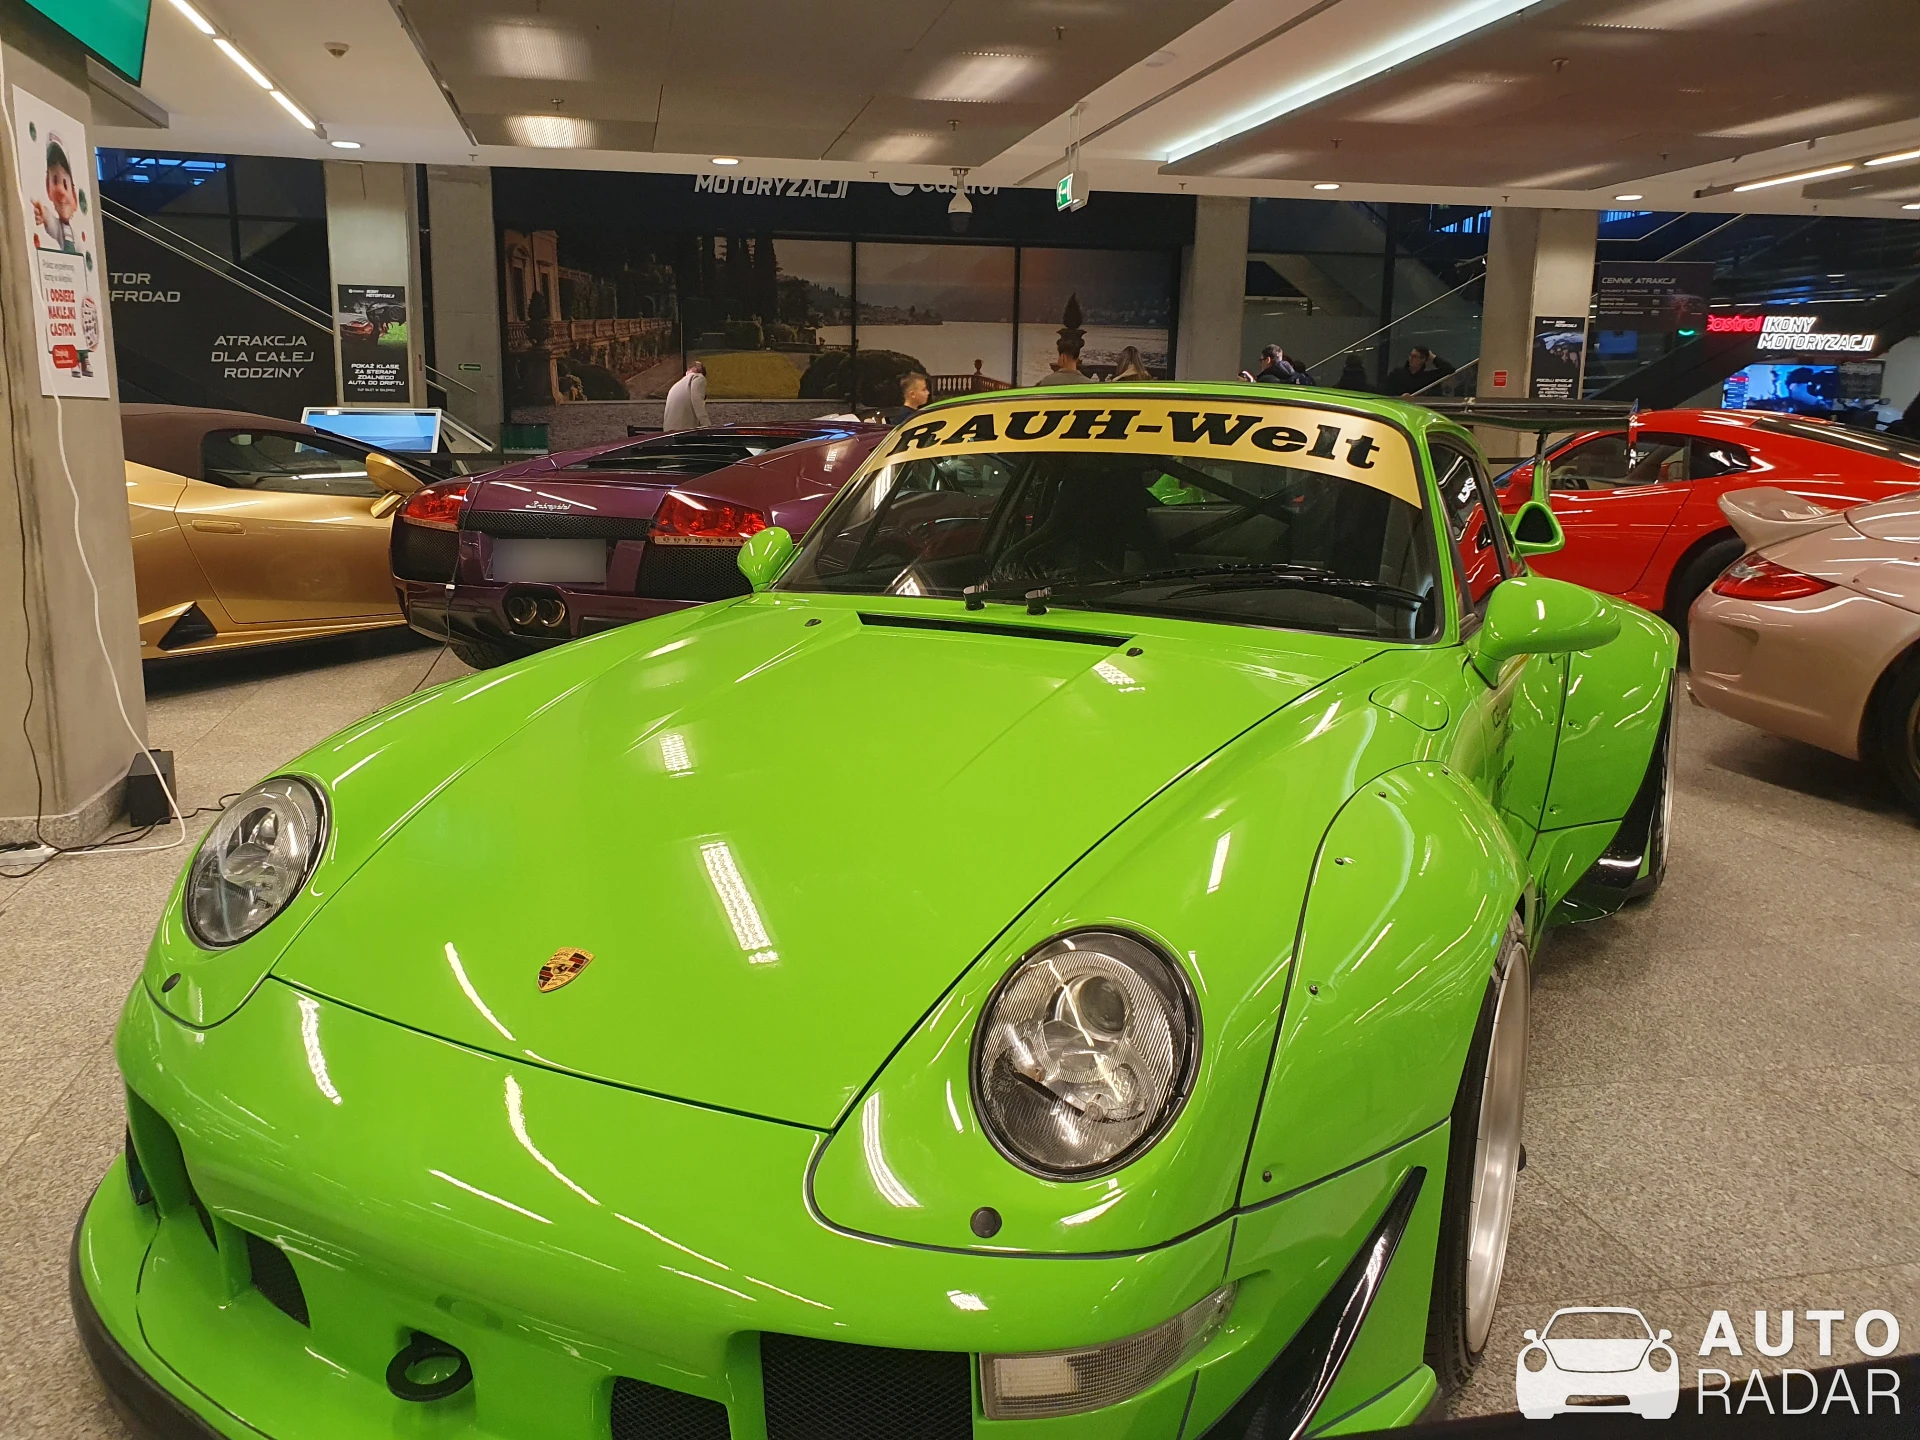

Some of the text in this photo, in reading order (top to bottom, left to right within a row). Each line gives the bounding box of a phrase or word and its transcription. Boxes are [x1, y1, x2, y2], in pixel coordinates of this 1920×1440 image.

[694, 174, 849, 199] MOTORYZACJI
[110, 272, 151, 285] TOR
[1635, 277, 1677, 285] ATRAKCJI
[50, 288, 75, 303] ODBIERZ
[108, 290, 181, 303] FROAD
[48, 305, 76, 320] NAKLEJKI
[50, 322, 76, 337] CASTROL
[1762, 316, 1817, 333] IKONY
[214, 335, 308, 346] ATRAKCJA
[1757, 333, 1876, 351] MOTORYZACJI
[211, 351, 315, 362] DLA CAŁEJ
[224, 367, 304, 379] RODZINY
[886, 408, 1381, 470] RAUH-Welt
